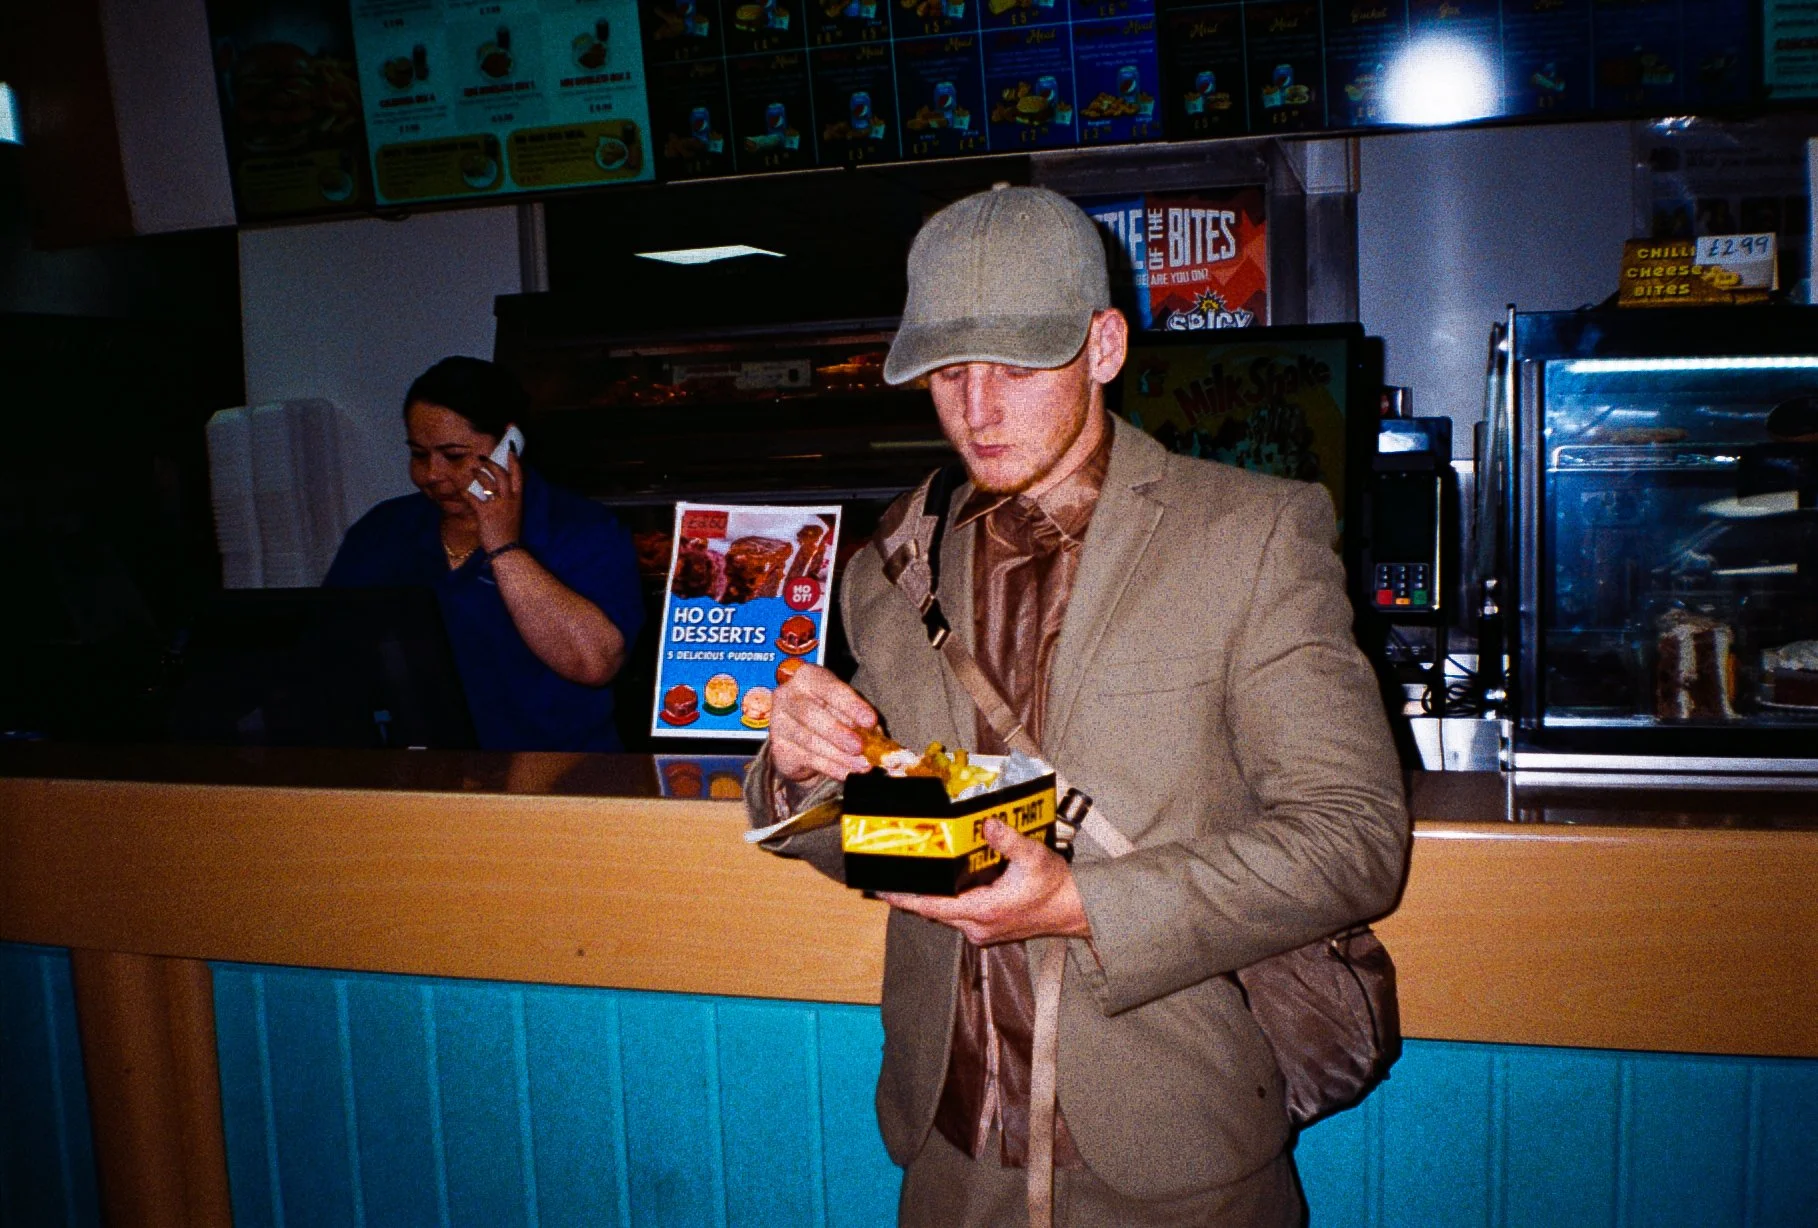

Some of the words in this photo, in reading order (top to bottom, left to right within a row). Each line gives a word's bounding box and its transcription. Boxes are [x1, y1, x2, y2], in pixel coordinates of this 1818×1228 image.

[1148, 207, 1164, 243] THE
[1092, 208, 1144, 270] TLE
[1168, 207, 1236, 268] BITES
[1148, 247, 1164, 271] OF
[1150, 272, 1168, 286] ARE
[1171, 270, 1190, 283] YOU
[1191, 268, 1209, 282] ON?
[1173, 364, 1244, 425] Milk
[1243, 354, 1331, 405] Shake
[792, 584, 811, 594] HO
[792, 593, 812, 603] OT!
[674, 607, 704, 624] HO
[708, 607, 736, 624] OT
[672, 626, 766, 644] DESSERTS
[676, 651, 726, 661] DELICIOUS
[727, 651, 776, 662] PUDDINGS
[1013, 799, 1045, 832] THAT
